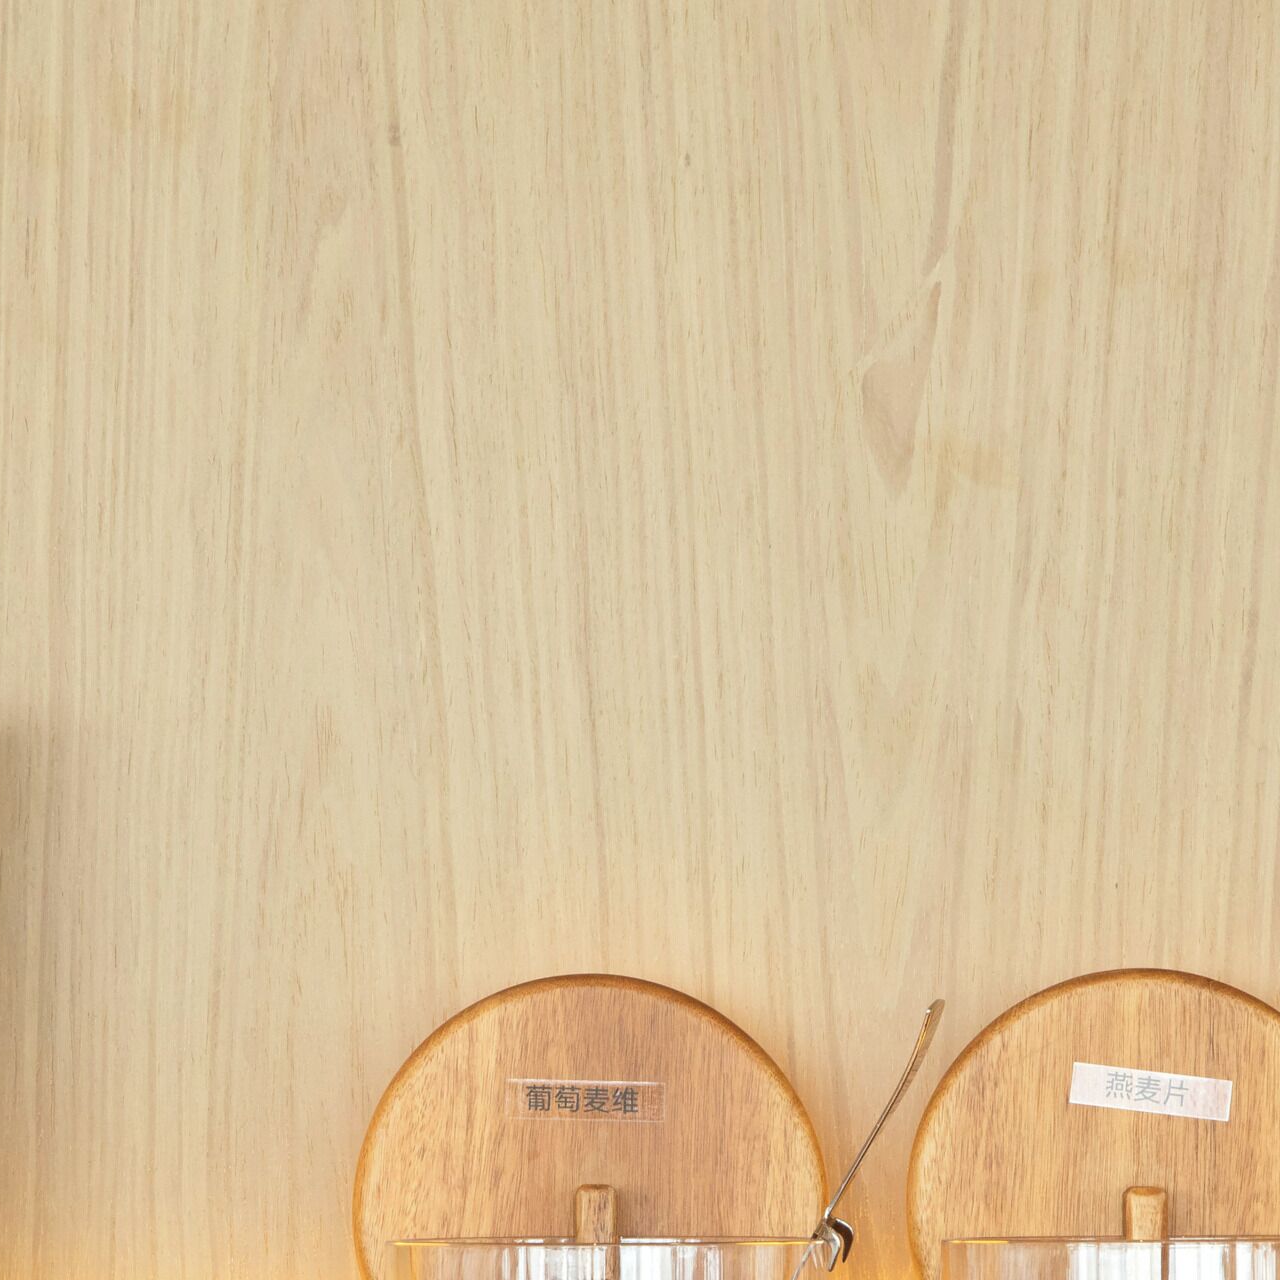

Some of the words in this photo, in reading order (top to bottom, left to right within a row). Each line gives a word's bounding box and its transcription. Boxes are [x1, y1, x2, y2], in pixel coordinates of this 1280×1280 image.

[526, 1083, 639, 1115] 葡萄麦维
[1106, 1071, 1189, 1108] 燕麦片
